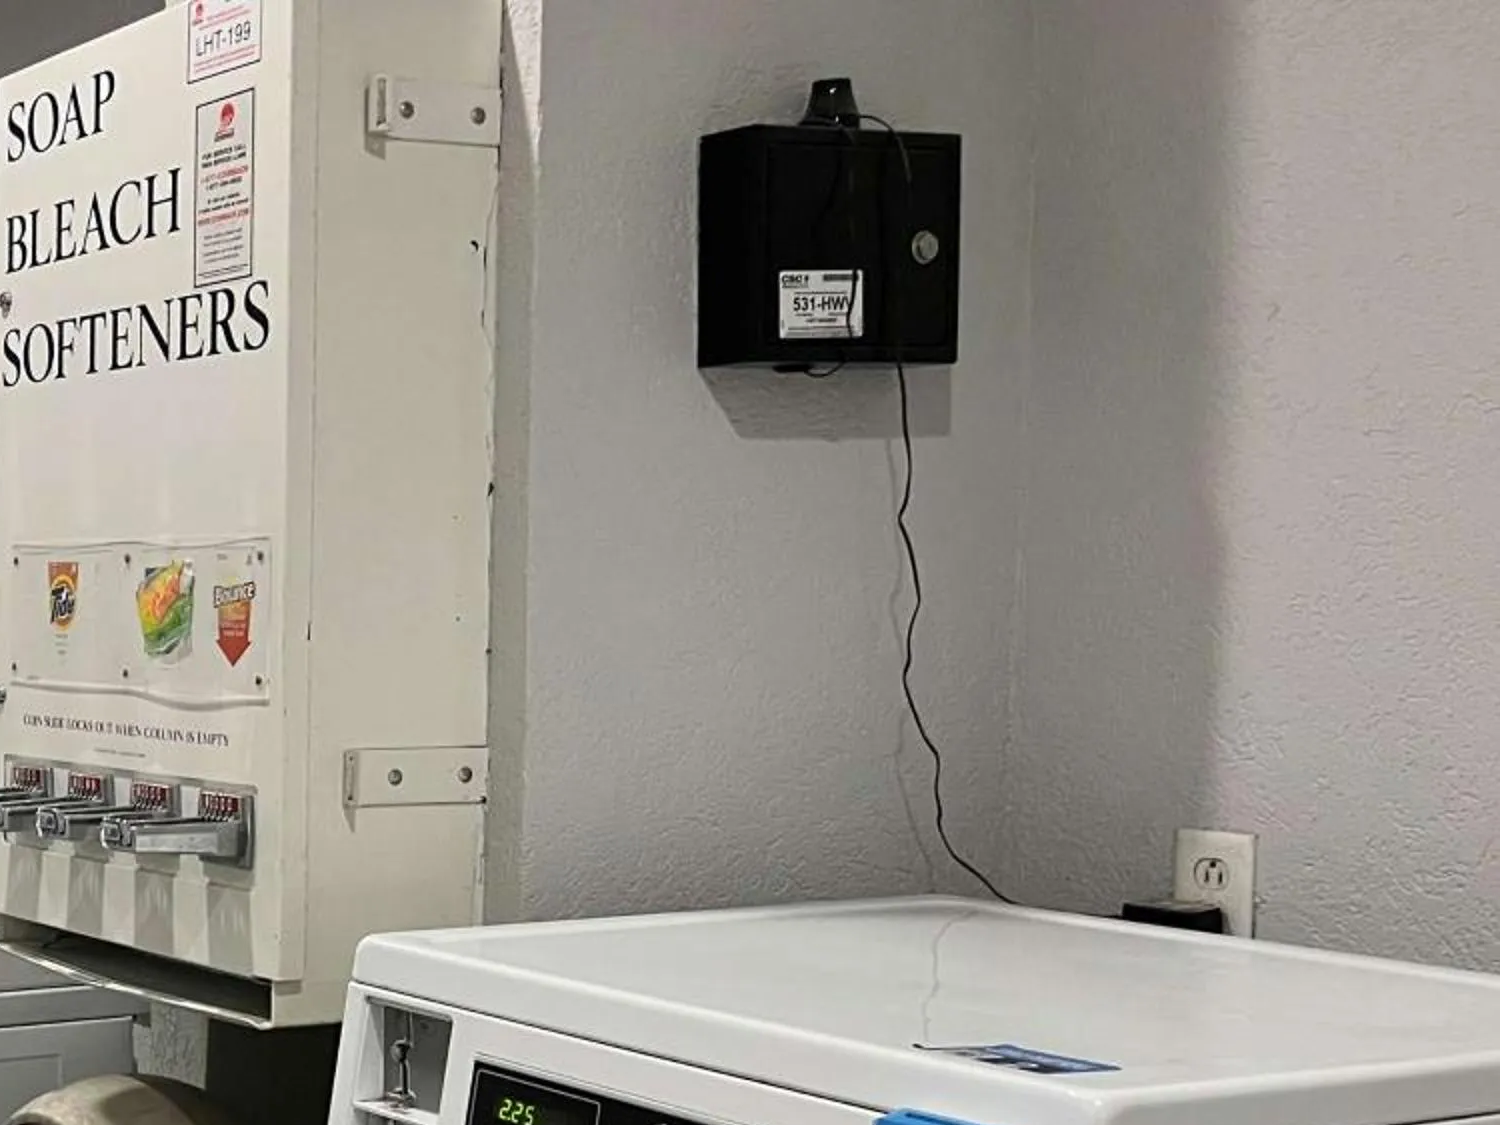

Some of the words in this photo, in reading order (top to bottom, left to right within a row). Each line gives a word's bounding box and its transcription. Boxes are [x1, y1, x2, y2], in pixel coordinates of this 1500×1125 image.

[196, 20, 251, 56] LHT-199
[7, 70, 115, 163] SOAP
[6, 167, 181, 274] BLEACH
[3, 280, 270, 387] SOFTENERS
[65, 718, 92, 732] LOCKS
[95, 721, 113, 734] OUT
[115, 723, 141, 736] WHEN
[143, 727, 183, 742] COLUMN
[186, 731, 195, 743] IS
[197, 731, 229, 747] EMPTY
